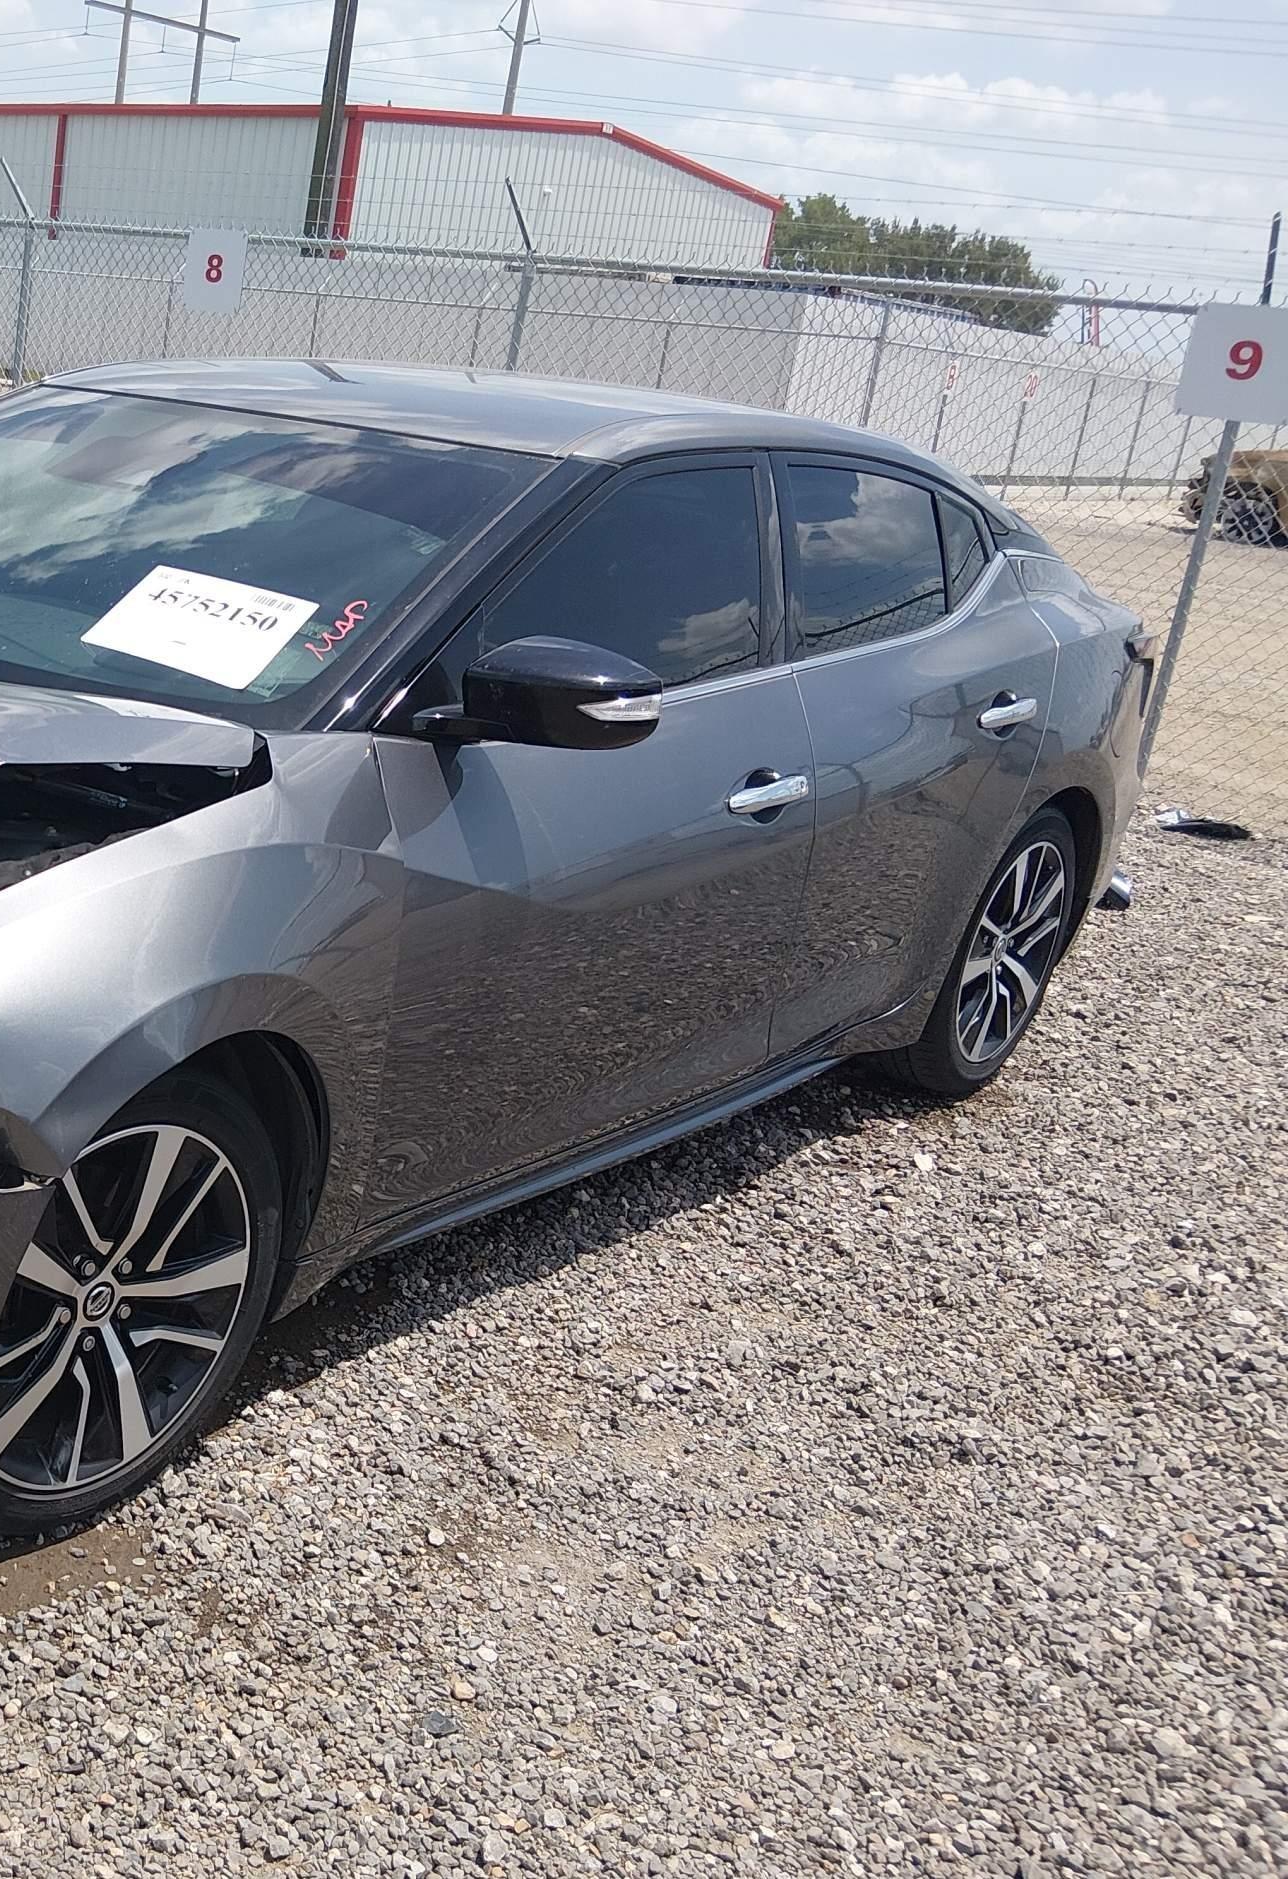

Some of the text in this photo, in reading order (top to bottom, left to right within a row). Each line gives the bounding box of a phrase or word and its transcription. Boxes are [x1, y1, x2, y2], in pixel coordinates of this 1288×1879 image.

[206, 254, 223, 283] 8
[1225, 340, 1263, 381] 9
[148, 587, 279, 632] 45752150
